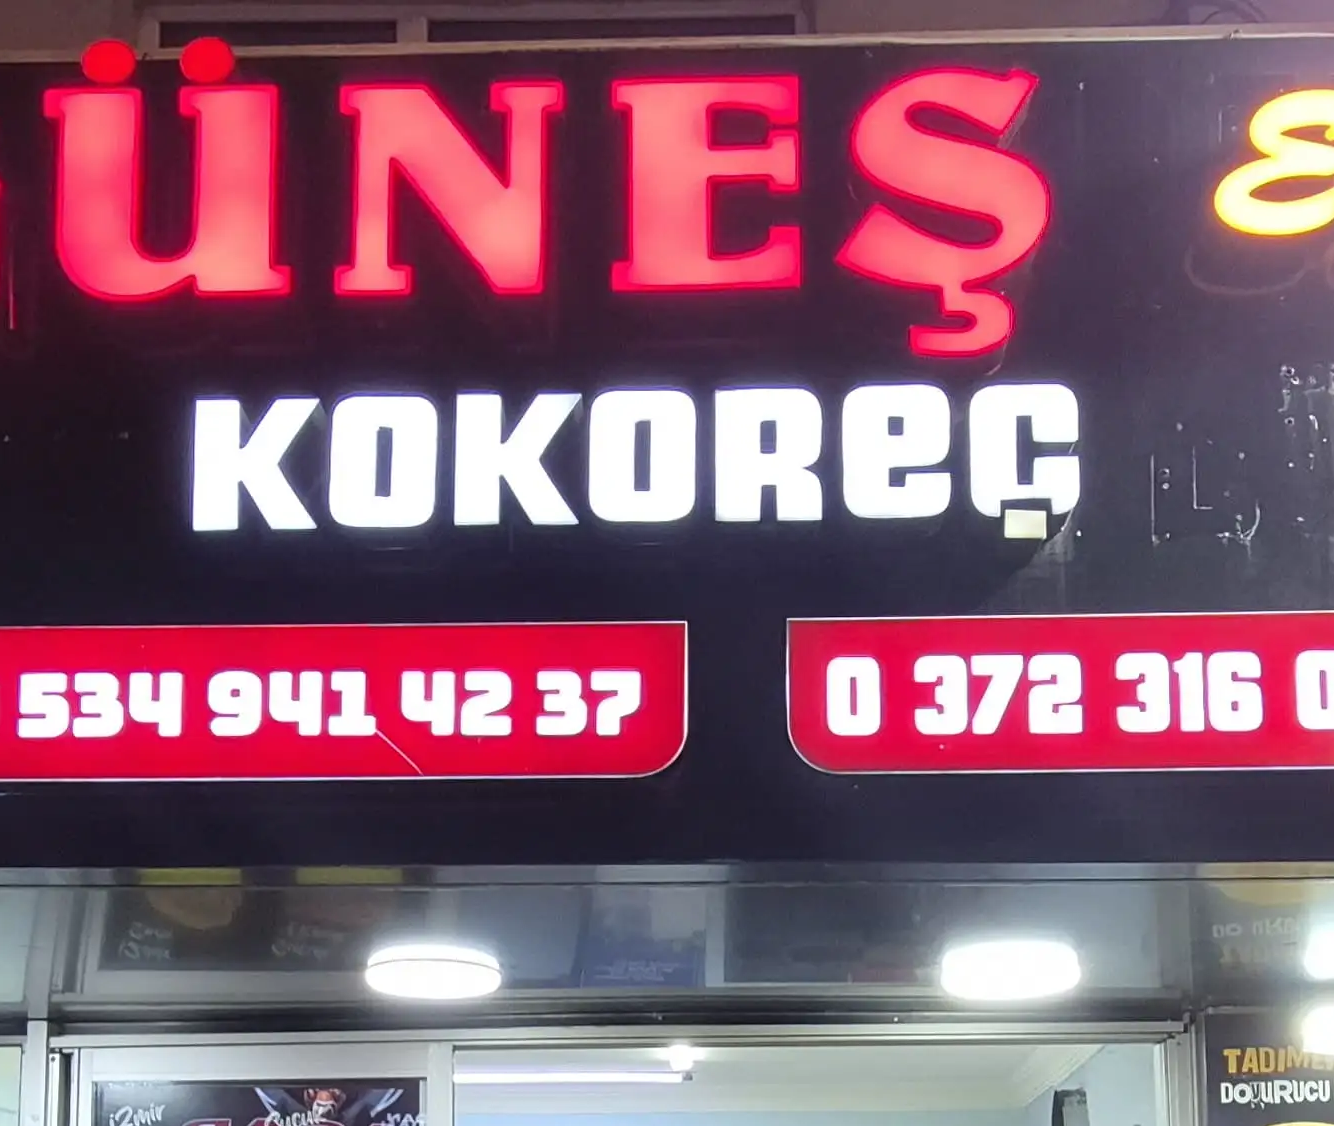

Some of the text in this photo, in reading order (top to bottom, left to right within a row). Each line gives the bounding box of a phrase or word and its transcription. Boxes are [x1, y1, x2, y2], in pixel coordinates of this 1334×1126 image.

[17, 671, 184, 739] 534
[207, 670, 377, 737] 941
[400, 670, 513, 737] 42
[535, 670, 642, 737] 37
[825, 655, 882, 737] 0
[912, 652, 1084, 736] 372
[1114, 650, 1264, 734] 316
